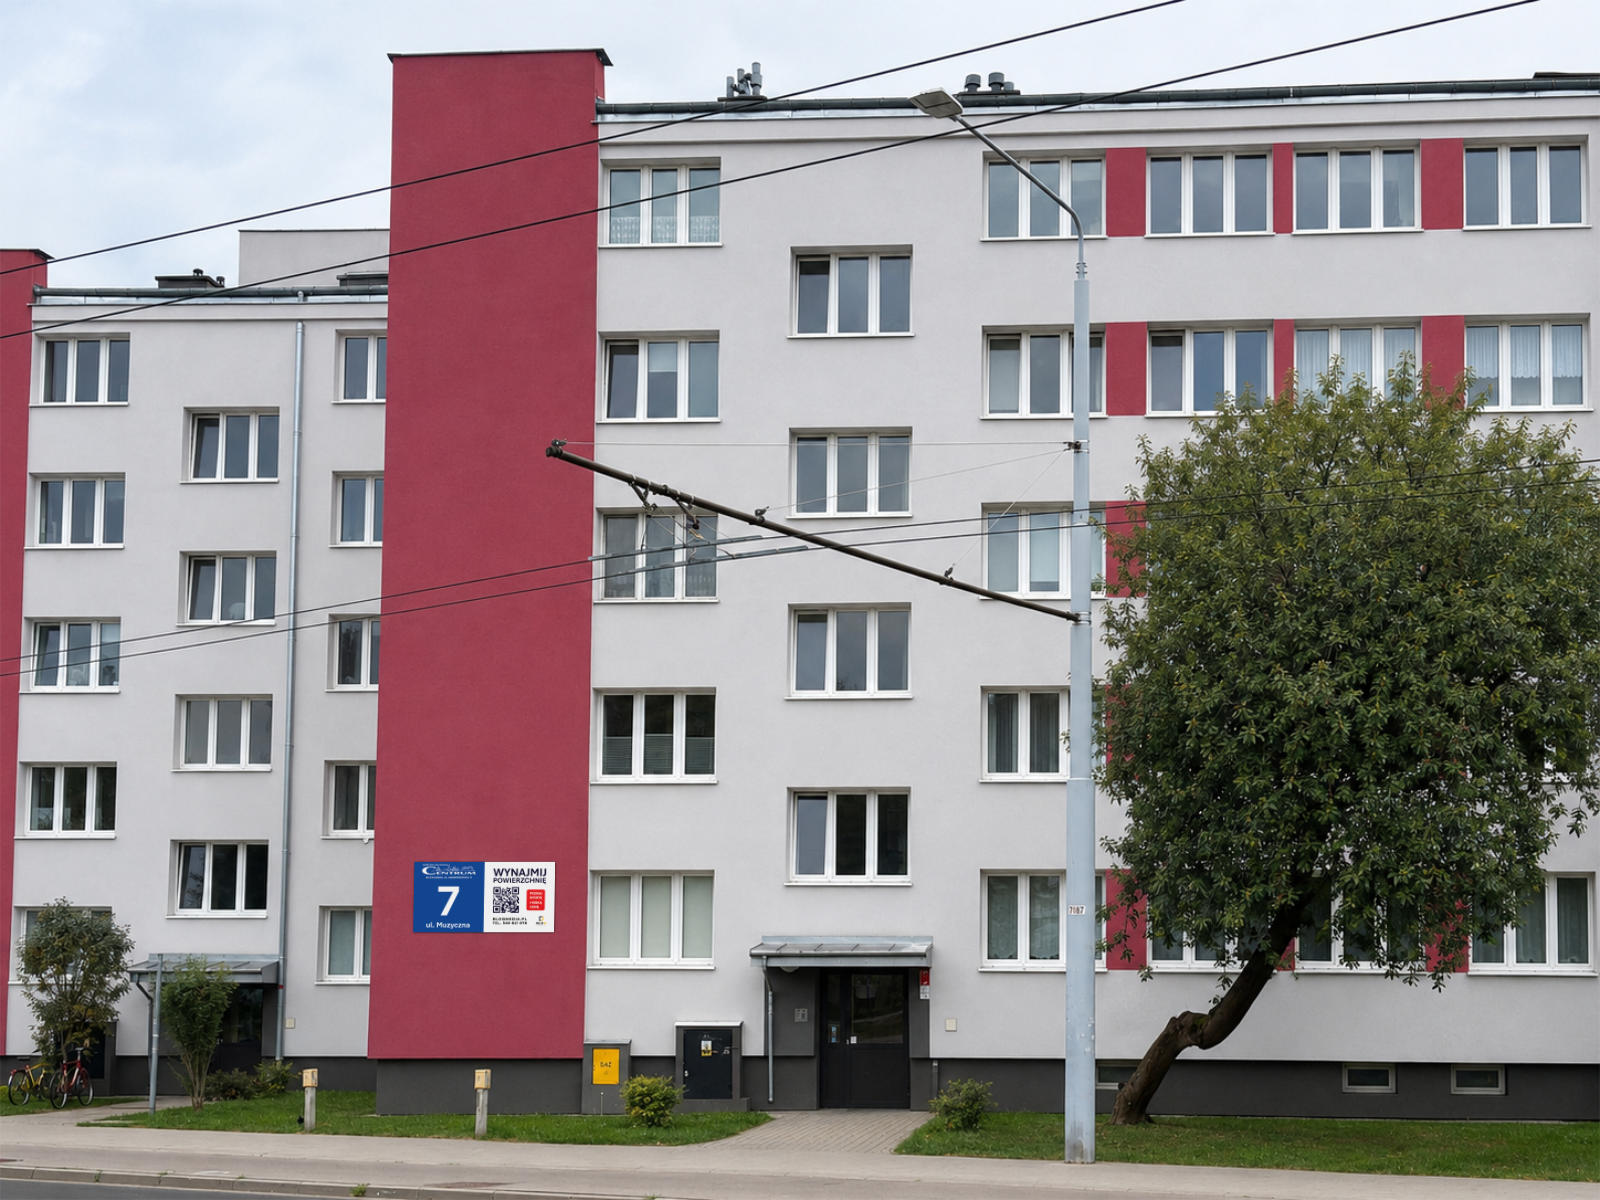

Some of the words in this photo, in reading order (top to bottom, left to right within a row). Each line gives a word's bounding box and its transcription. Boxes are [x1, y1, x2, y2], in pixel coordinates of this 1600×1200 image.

[493, 868, 547, 877] WYNAJMIJ
[493, 877, 547, 885] POWIERZCHNIĘ
[438, 886, 460, 917] 7
[425, 921, 435, 929] ul.
[436, 921, 471, 930] Muzyczna
